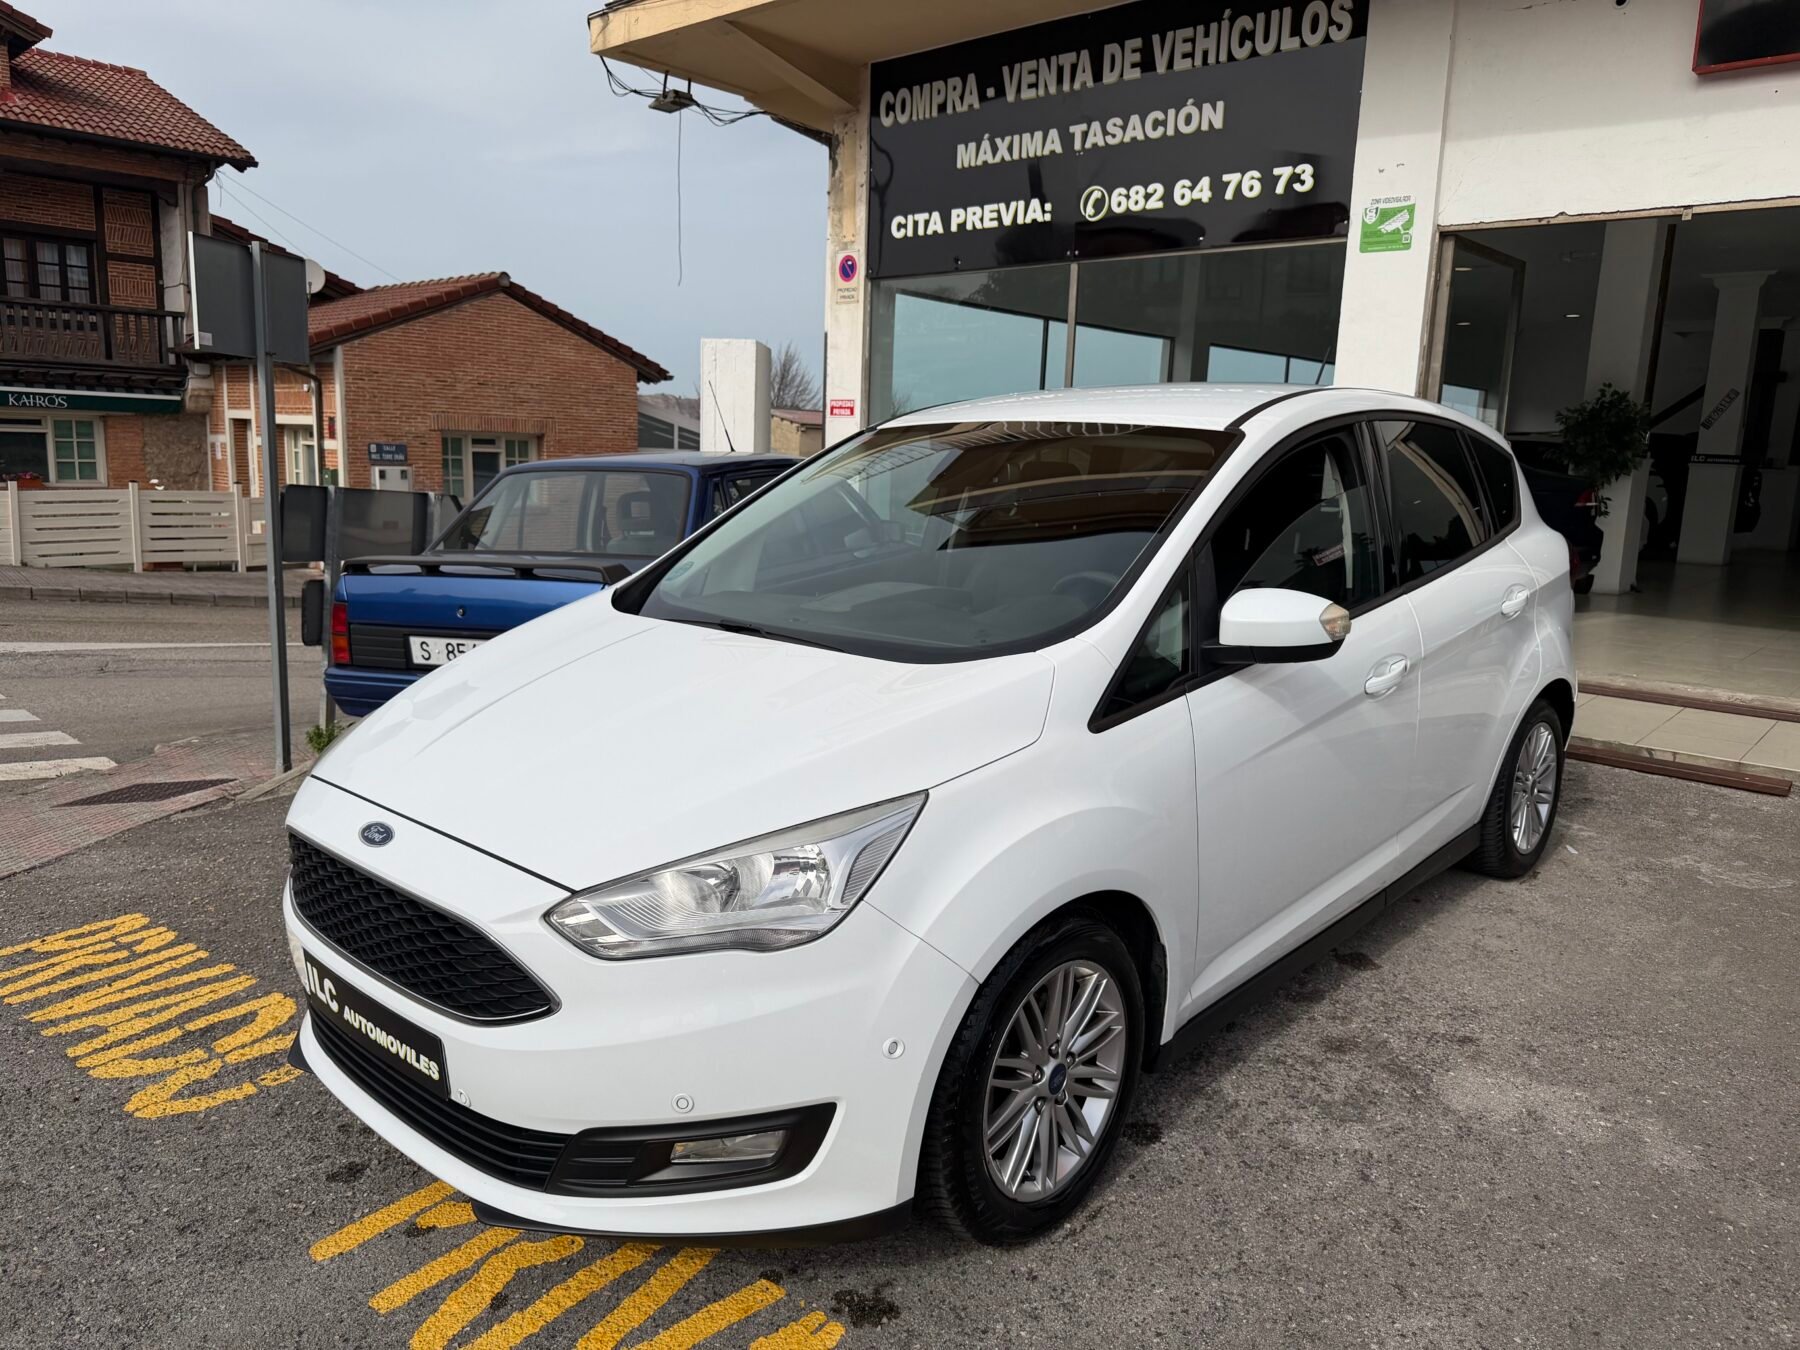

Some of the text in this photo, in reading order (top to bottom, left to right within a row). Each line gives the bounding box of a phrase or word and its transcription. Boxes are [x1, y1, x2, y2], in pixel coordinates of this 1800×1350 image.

[879, 72, 980, 127] COMPRA
[1002, 49, 1094, 103] VENTA
[1102, 37, 1143, 85] DE
[1152, 0, 1354, 75] VEHÍCULOS
[956, 98, 1225, 169] MÁXIMA TASACIÓN
[891, 163, 1315, 239] CITA PREVIA: 682 64 76 73
[364, 825, 387, 842] Ford
[344, 1005, 440, 1081] AUTOMOVILES
